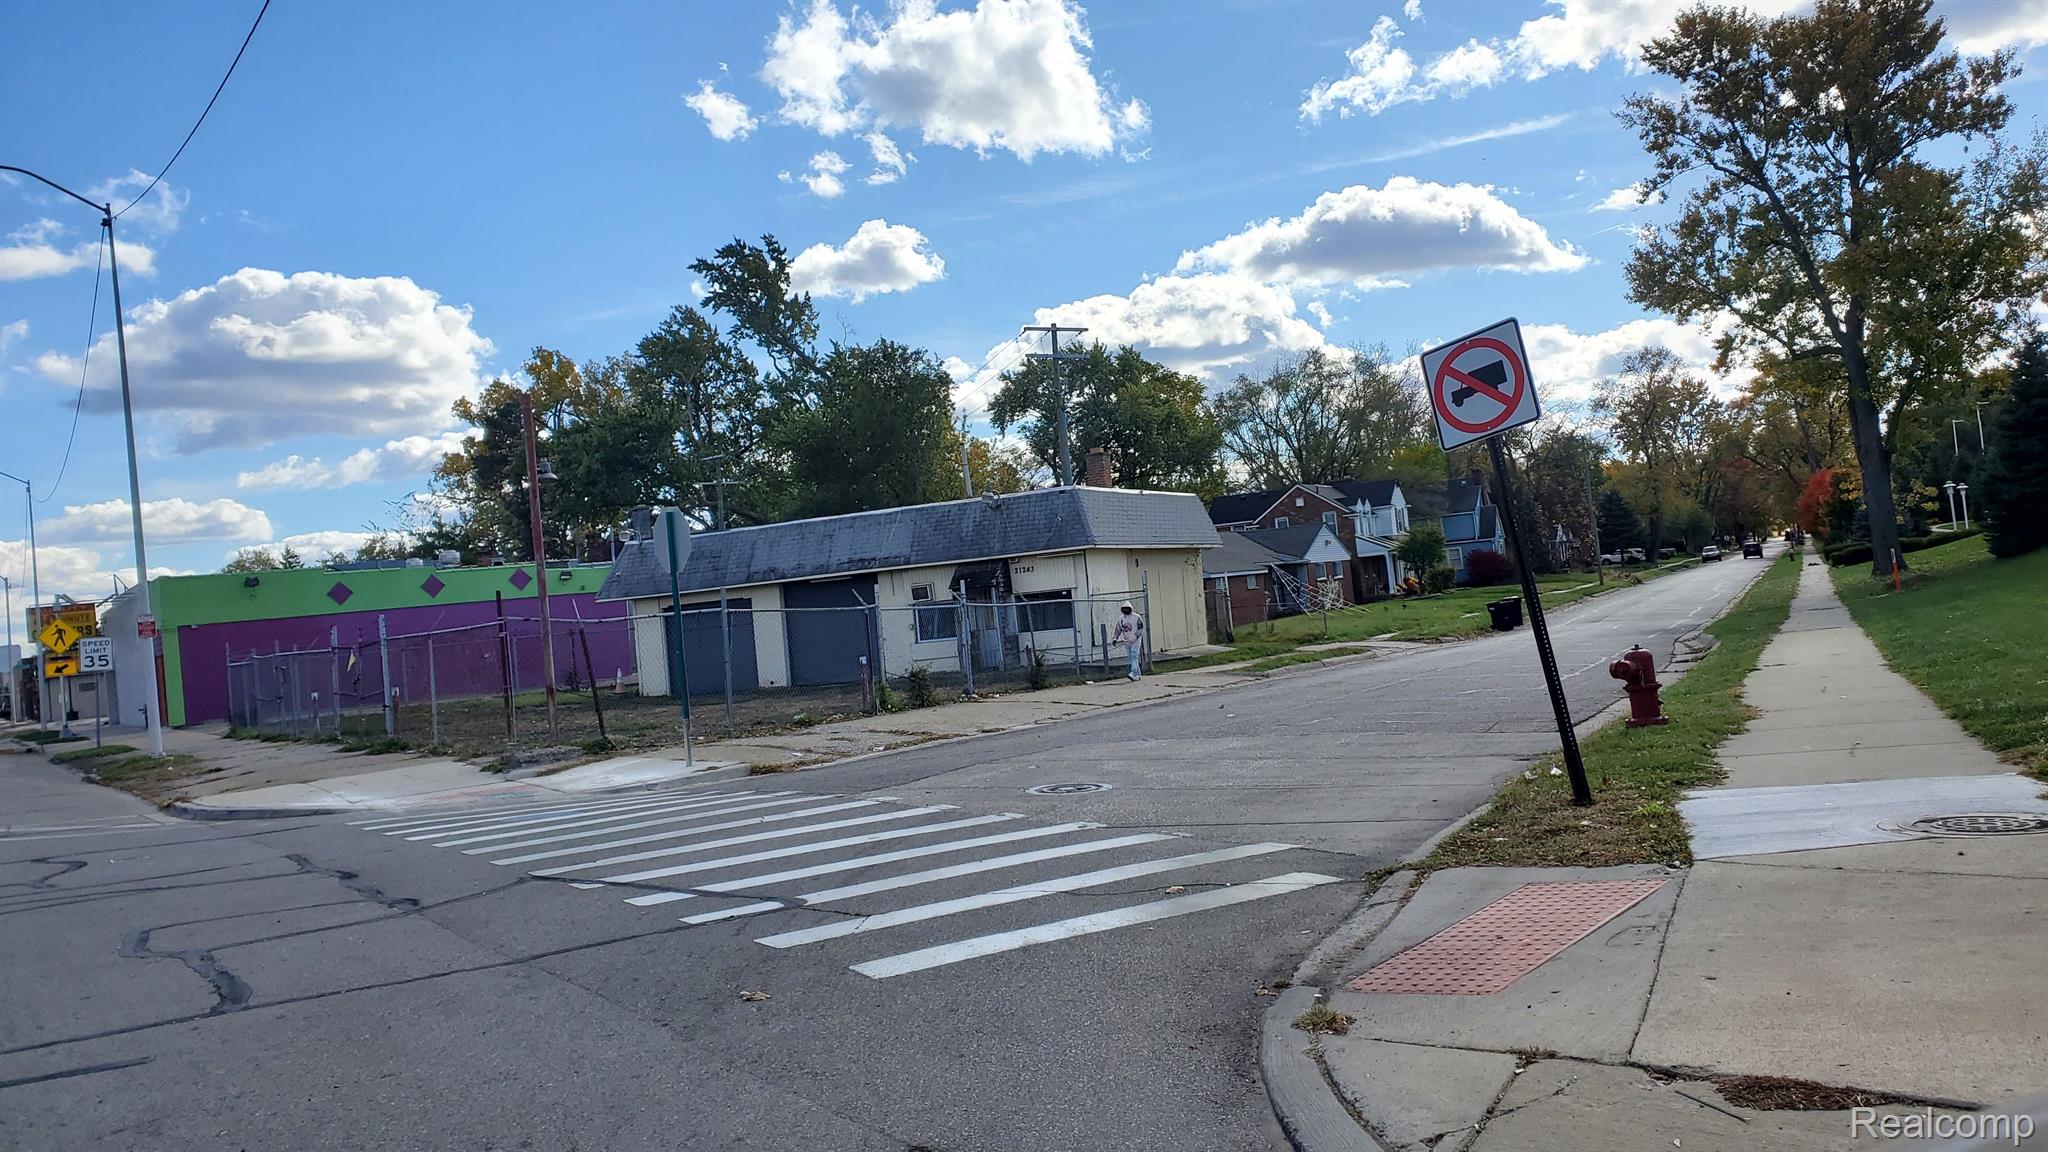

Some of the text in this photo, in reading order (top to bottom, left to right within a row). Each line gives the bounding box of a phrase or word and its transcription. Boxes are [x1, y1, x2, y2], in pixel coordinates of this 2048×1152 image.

[82, 640, 110, 648] SPEED
[85, 647, 107, 655] LIMIT
[84, 655, 109, 668] 35
